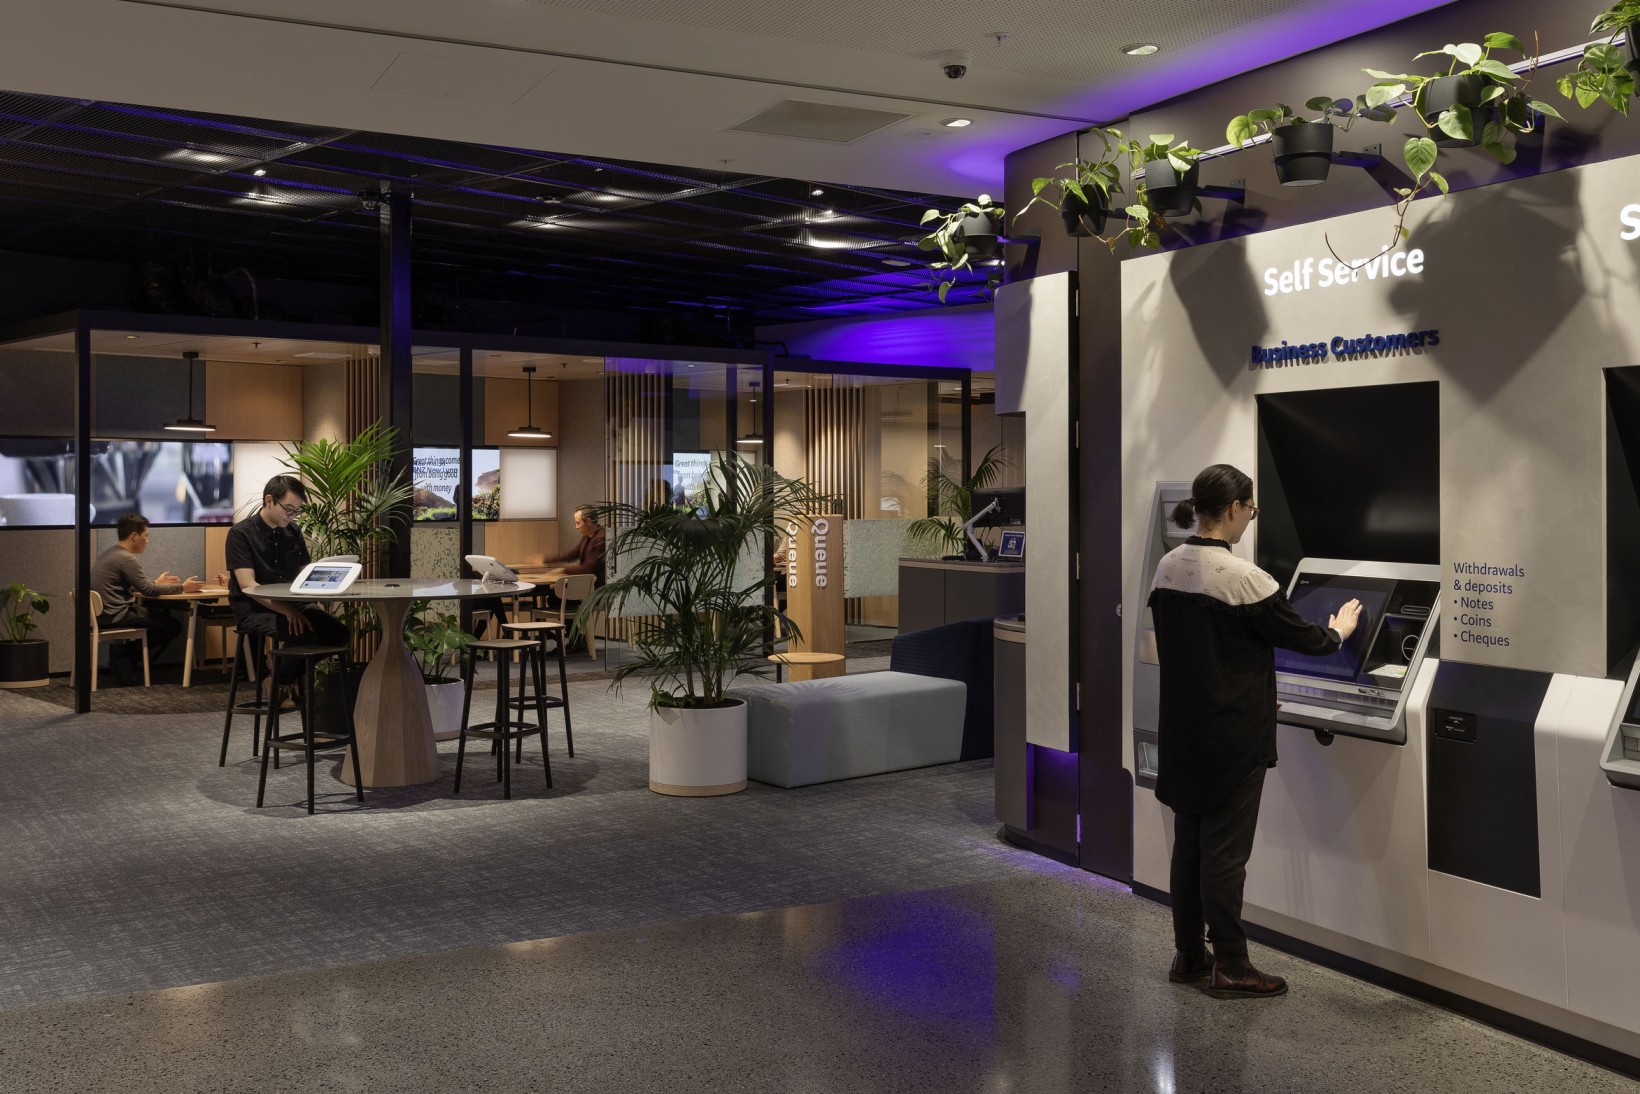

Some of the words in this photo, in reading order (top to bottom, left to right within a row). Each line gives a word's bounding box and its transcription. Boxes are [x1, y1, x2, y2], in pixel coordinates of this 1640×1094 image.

[1264, 257, 1314, 296] Self
[1318, 245, 1424, 287] Service
[1251, 340, 1328, 364] Business
[1330, 330, 1439, 355] Customers
[675, 460, 690, 468] Great
[433, 485, 452, 494] money
[786, 519, 799, 587] Queue
[811, 519, 829, 587] Queue
[1453, 562, 1525, 577] Withdrawals
[1453, 579, 1461, 591] &
[1464, 579, 1513, 595] deposits
[1461, 597, 1494, 610] Notes
[1461, 614, 1492, 627] Coins
[1461, 630, 1510, 647] Cheques
